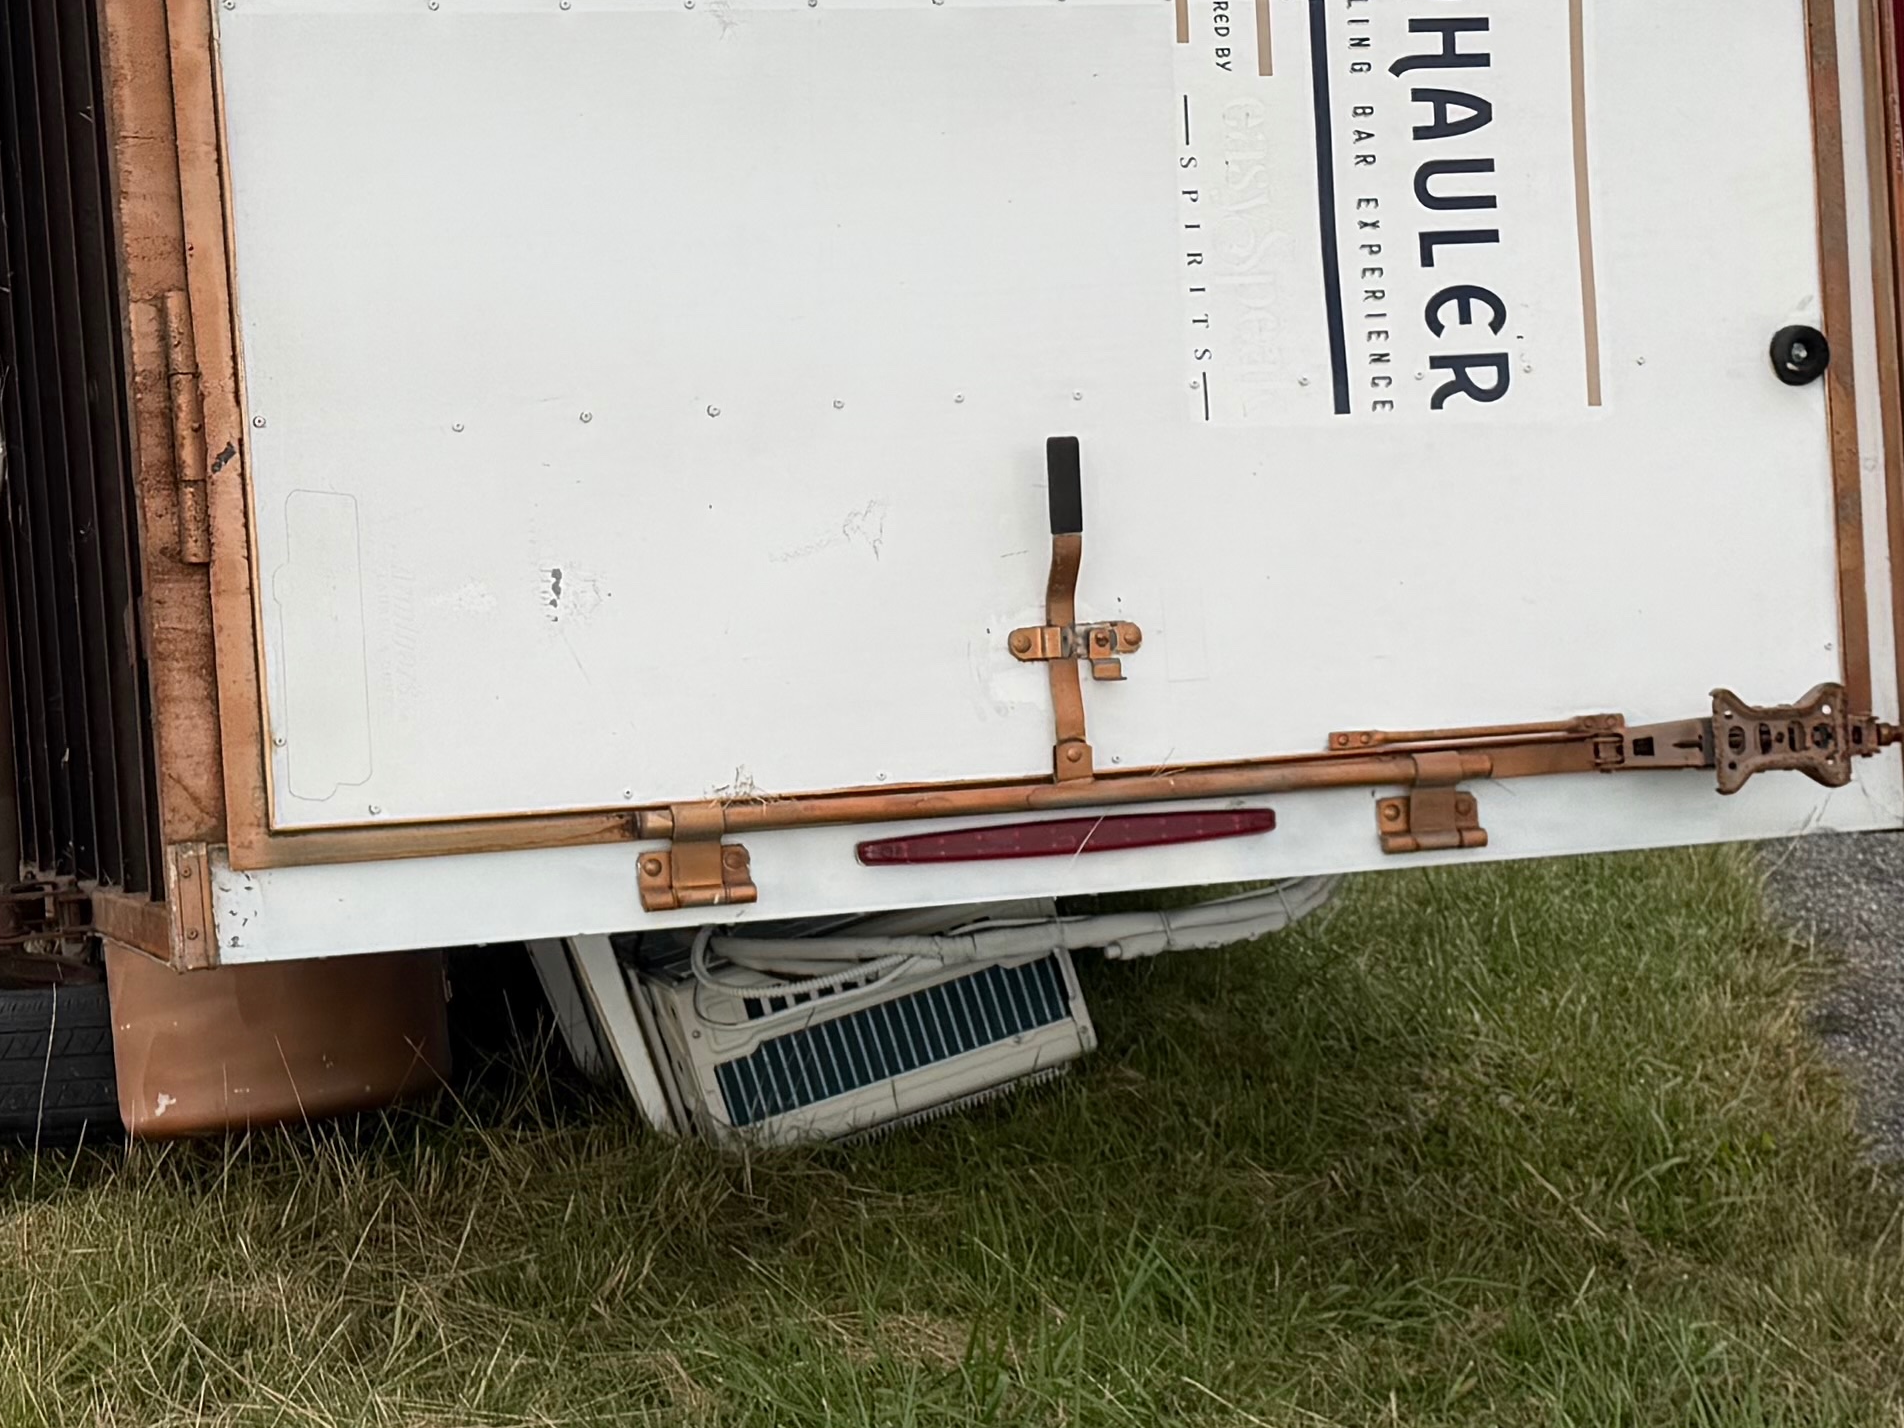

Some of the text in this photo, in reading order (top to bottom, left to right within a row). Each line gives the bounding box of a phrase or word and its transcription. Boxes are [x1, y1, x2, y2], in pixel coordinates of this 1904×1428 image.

[1214, 47, 1233, 72] BY
[1352, 105, 1377, 166] BAR
[1179, 155, 1212, 362] SPIRITS
[1357, 197, 1394, 412] EXPERIENCE
